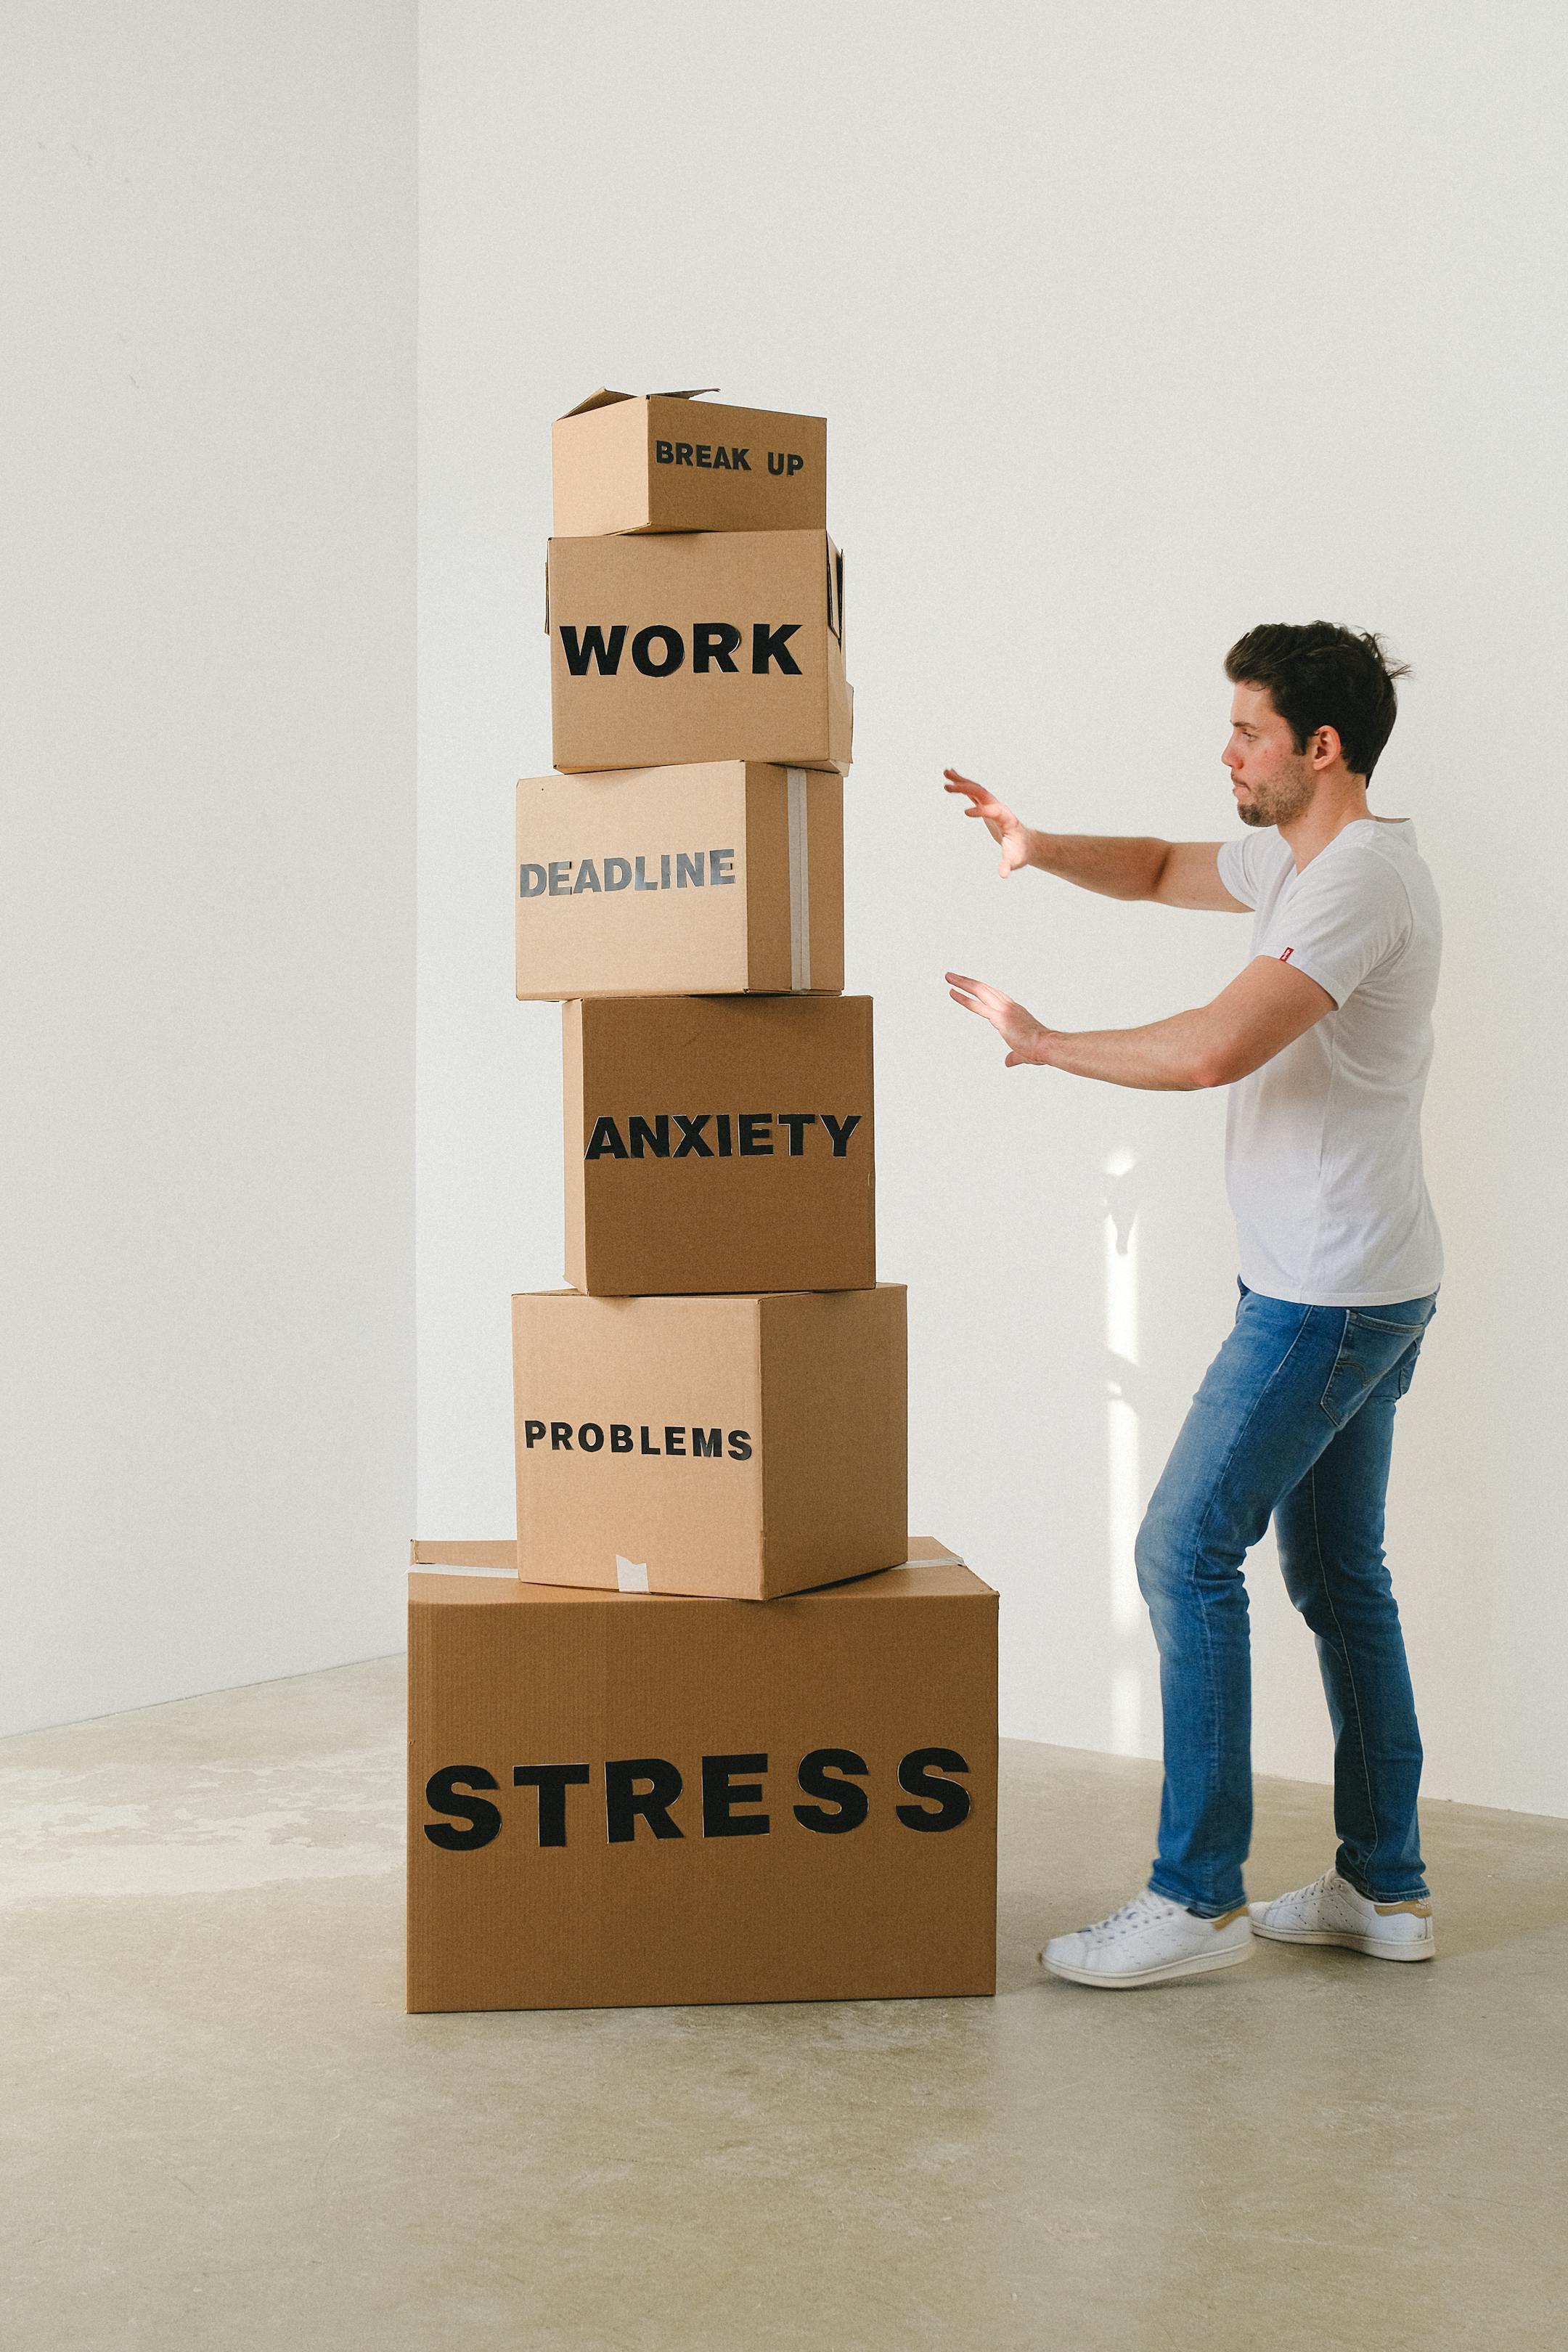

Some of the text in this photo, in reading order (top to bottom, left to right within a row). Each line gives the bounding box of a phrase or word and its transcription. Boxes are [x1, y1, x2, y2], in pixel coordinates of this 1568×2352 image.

[656, 440, 804, 477] BREAK UP
[559, 623, 803, 677] WORK
[519, 849, 735, 898] DEADLINE
[584, 1113, 862, 1160] ANXIETY
[525, 1420, 752, 1461] PROBLEMS
[424, 1747, 972, 1851] STRESS
